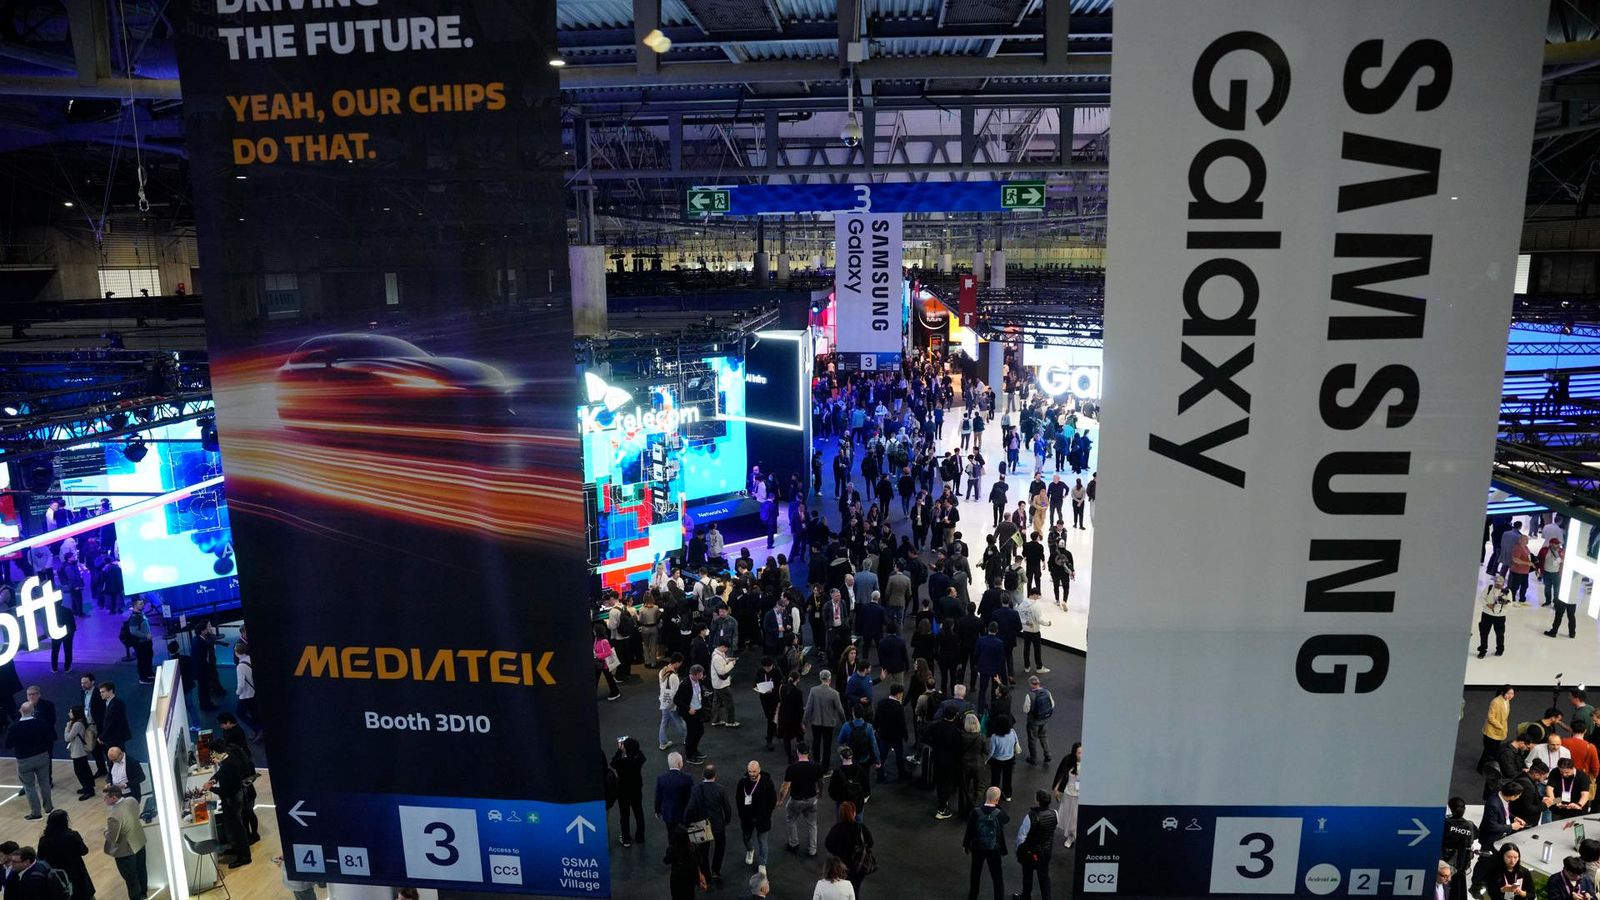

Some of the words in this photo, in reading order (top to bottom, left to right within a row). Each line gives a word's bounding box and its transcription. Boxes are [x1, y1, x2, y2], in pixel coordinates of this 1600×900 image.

[218, 24, 298, 60] THE
[305, 15, 474, 56] FUTURE.
[226, 91, 326, 123] YEAH,
[331, 87, 402, 118] OUR
[408, 82, 507, 113] CHIPS
[232, 136, 279, 165] DO
[285, 132, 377, 162] THAT.
[853, 185, 872, 212] 3
[844, 218, 865, 294] Galaxy
[1149, 30, 1291, 489] Galaxy
[871, 219, 890, 331] SAMSUNG
[864, 357, 873, 368] 3
[1295, 38, 1453, 694] SAMSUNG
[615, 405, 700, 431] telecom
[294, 645, 558, 686] MEDIATEK
[364, 711, 431, 732] Booth
[434, 714, 492, 734] 3D10
[423, 821, 460, 867] 3
[1450, 826, 1472, 836] PHOT
[302, 850, 317, 868] 4
[344, 854, 364, 868] 8.1
[488, 846, 512, 854] Access
[561, 856, 599, 868] GSMA
[1235, 831, 1275, 879] 3
[493, 865, 519, 876] CC3
[563, 868, 600, 879] Media
[1087, 874, 1115, 884] CC2
[1356, 873, 1371, 890] 2
[1404, 874, 1414, 891] 1
[560, 878, 600, 891] Village
